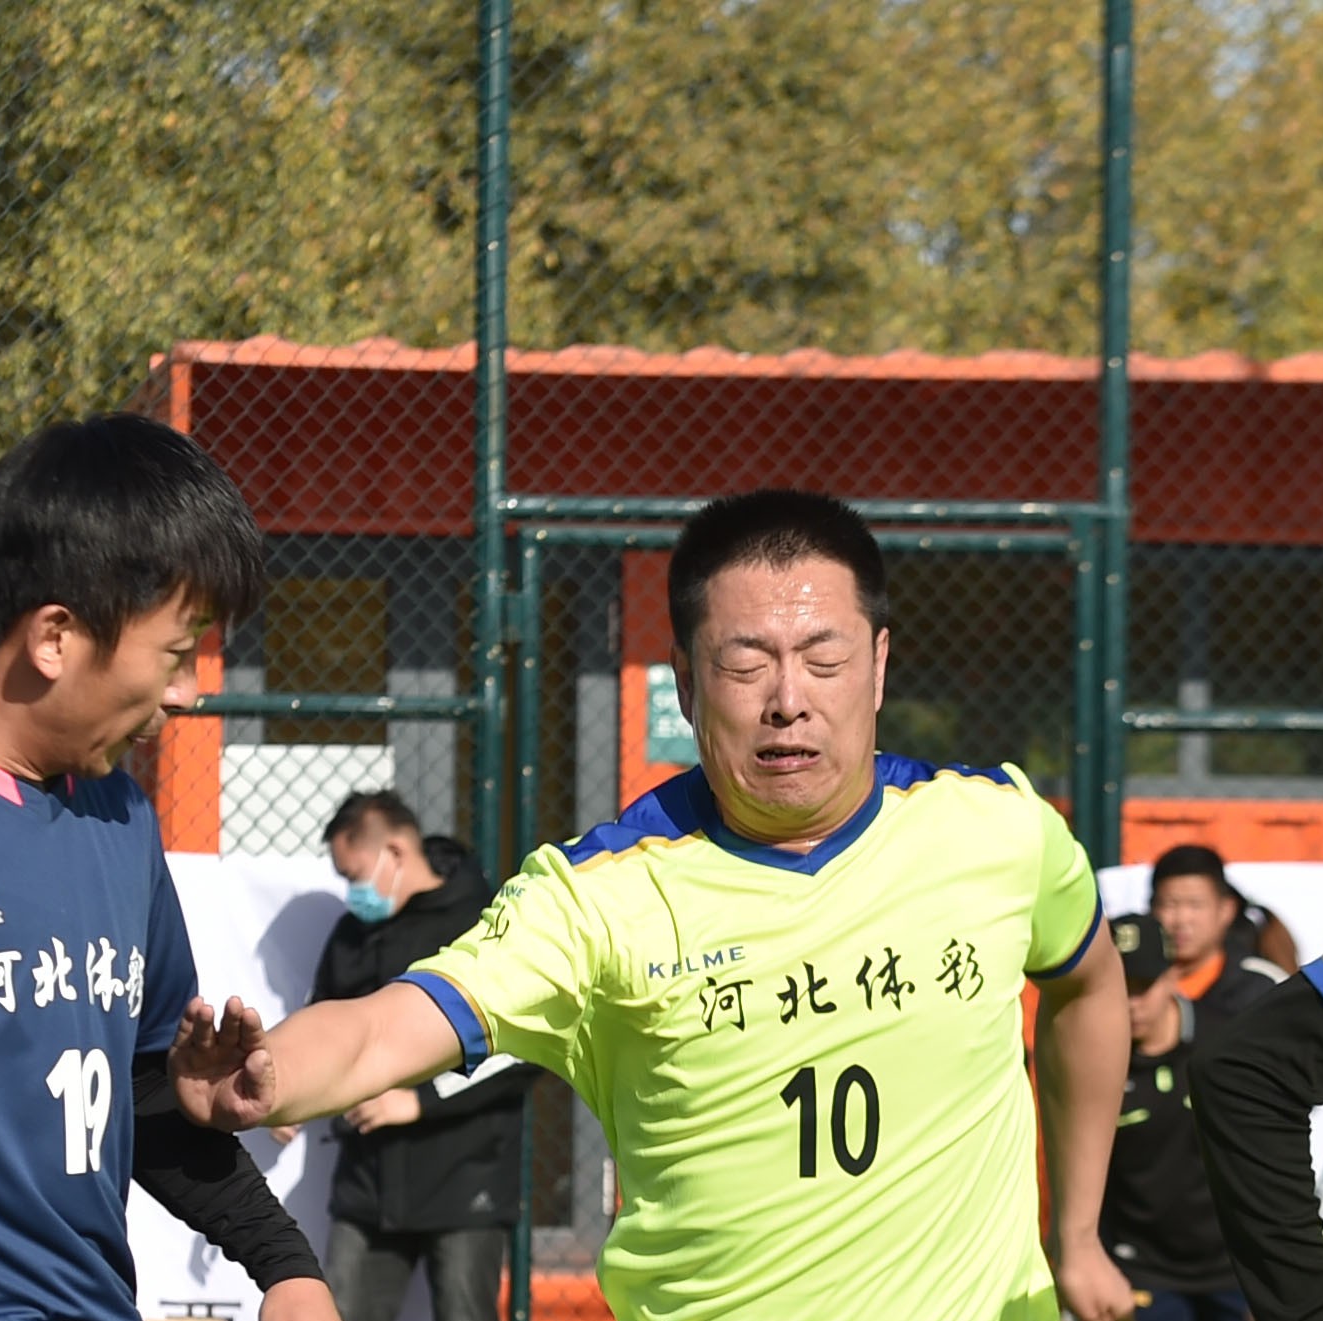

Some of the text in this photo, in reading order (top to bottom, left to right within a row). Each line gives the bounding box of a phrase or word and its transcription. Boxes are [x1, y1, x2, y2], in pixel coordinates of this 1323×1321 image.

[648, 945, 747, 979] KELME
[698, 937, 985, 1032] 河北体彩
[45, 1048, 112, 1175] 19
[780, 1064, 880, 1178] 10
